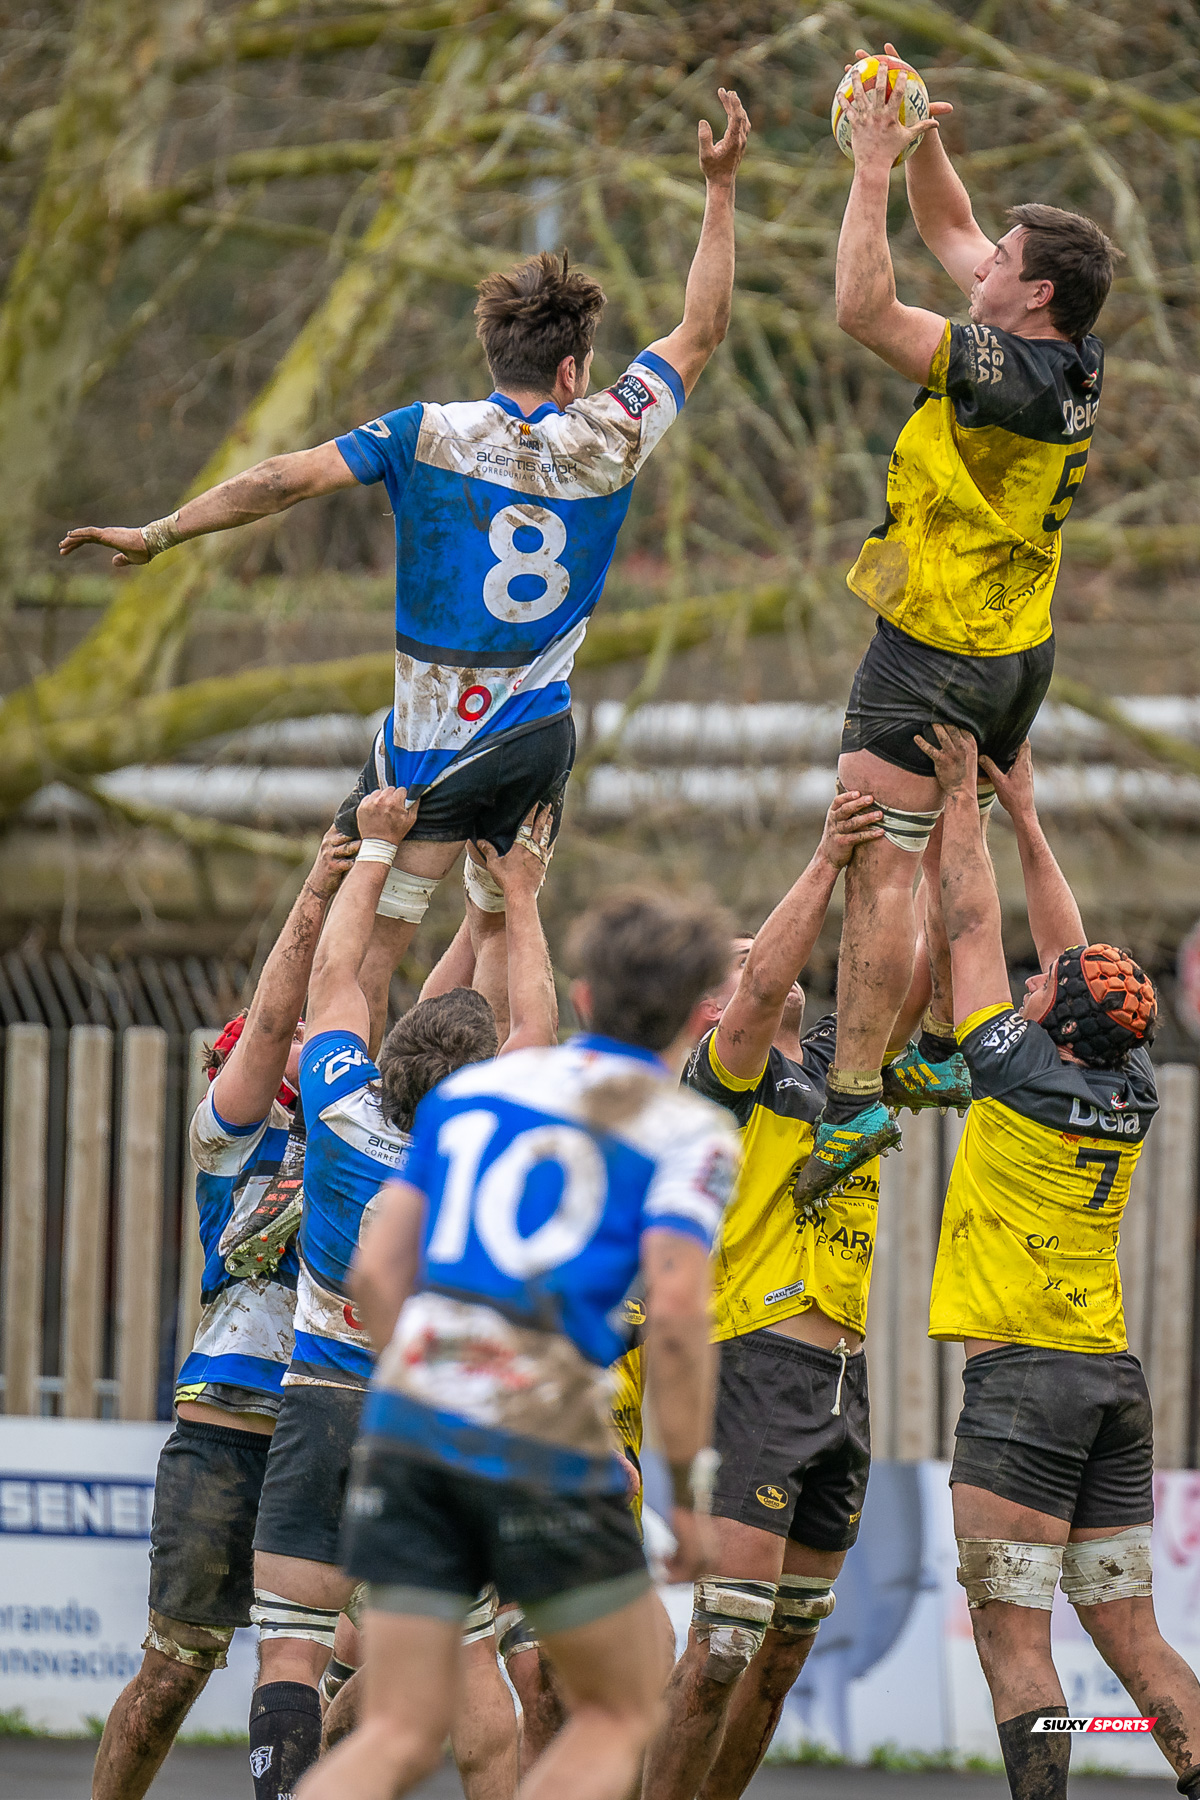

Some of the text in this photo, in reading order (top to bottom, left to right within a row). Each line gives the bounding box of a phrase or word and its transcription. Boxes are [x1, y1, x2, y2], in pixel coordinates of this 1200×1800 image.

[1042, 448, 1089, 533] 5
[483, 503, 571, 624] 8
[426, 1108, 609, 1281] 10
[1075, 1146, 1122, 1210] 7
[0, 1481, 156, 1534] SENE
